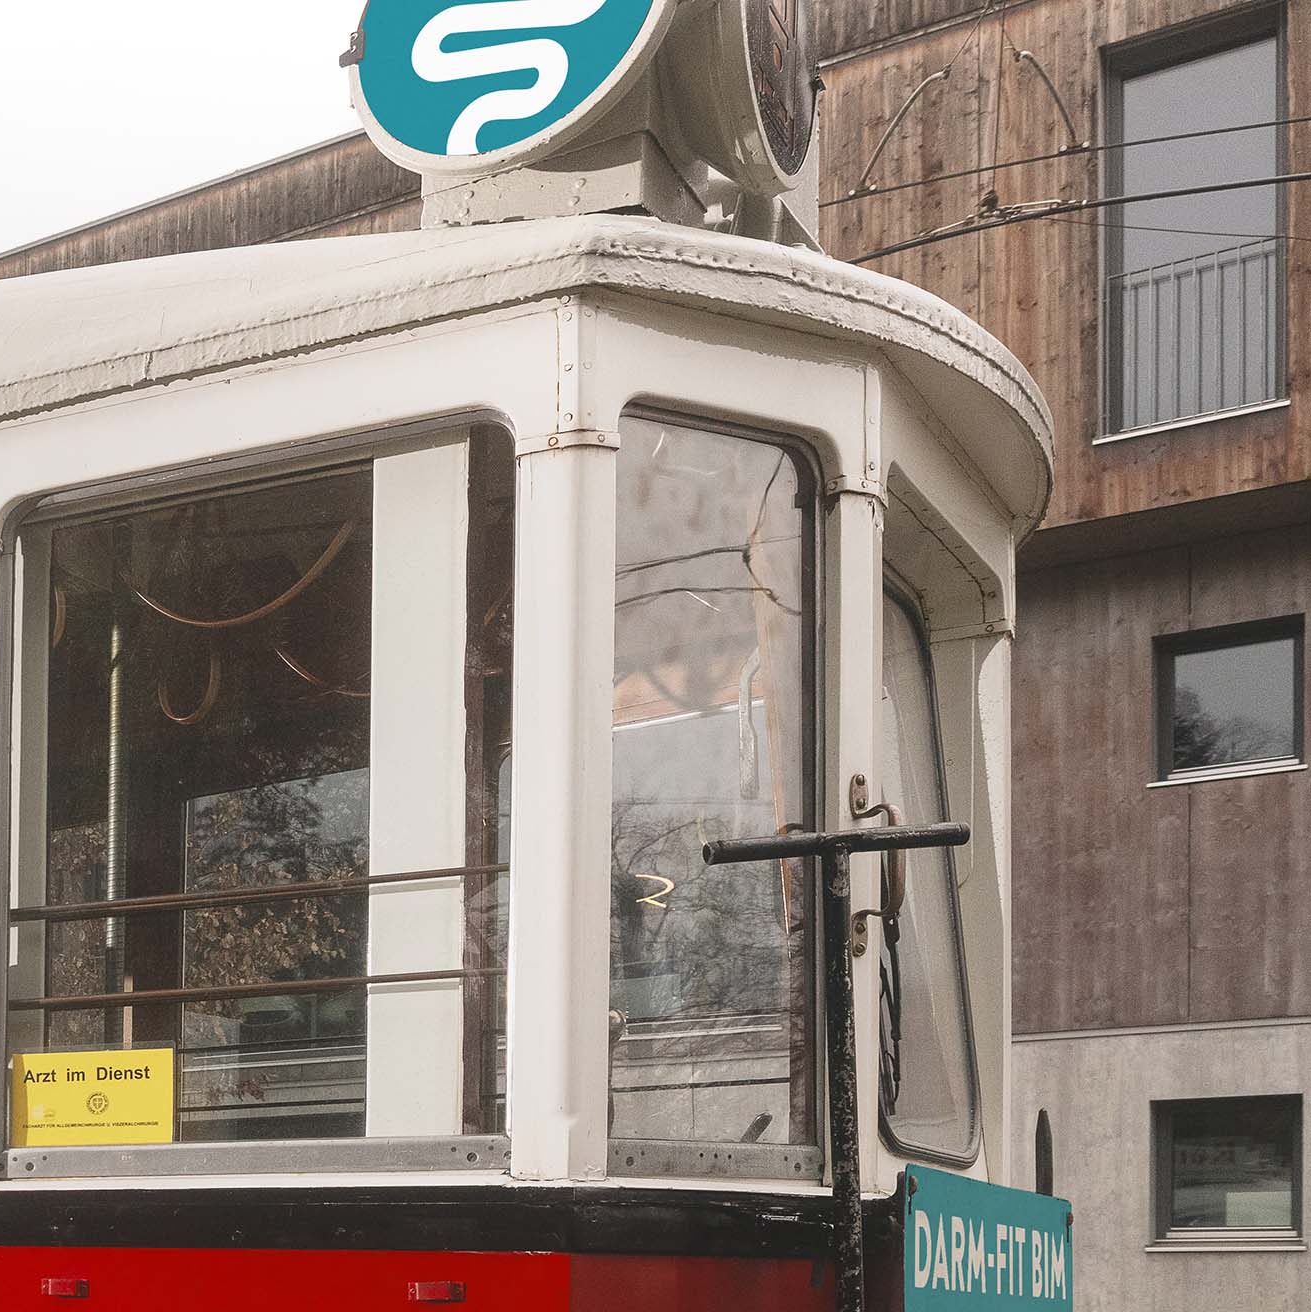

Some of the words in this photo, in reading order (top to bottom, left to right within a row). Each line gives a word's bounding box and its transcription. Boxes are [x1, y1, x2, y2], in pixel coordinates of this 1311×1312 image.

[23, 1069, 57, 1083] Arzt
[66, 1068, 86, 1082] im
[96, 1066, 150, 1081] Dienst
[914, 1209, 1026, 1297] DARM-FIT
[1031, 1229, 1067, 1300] BIM
